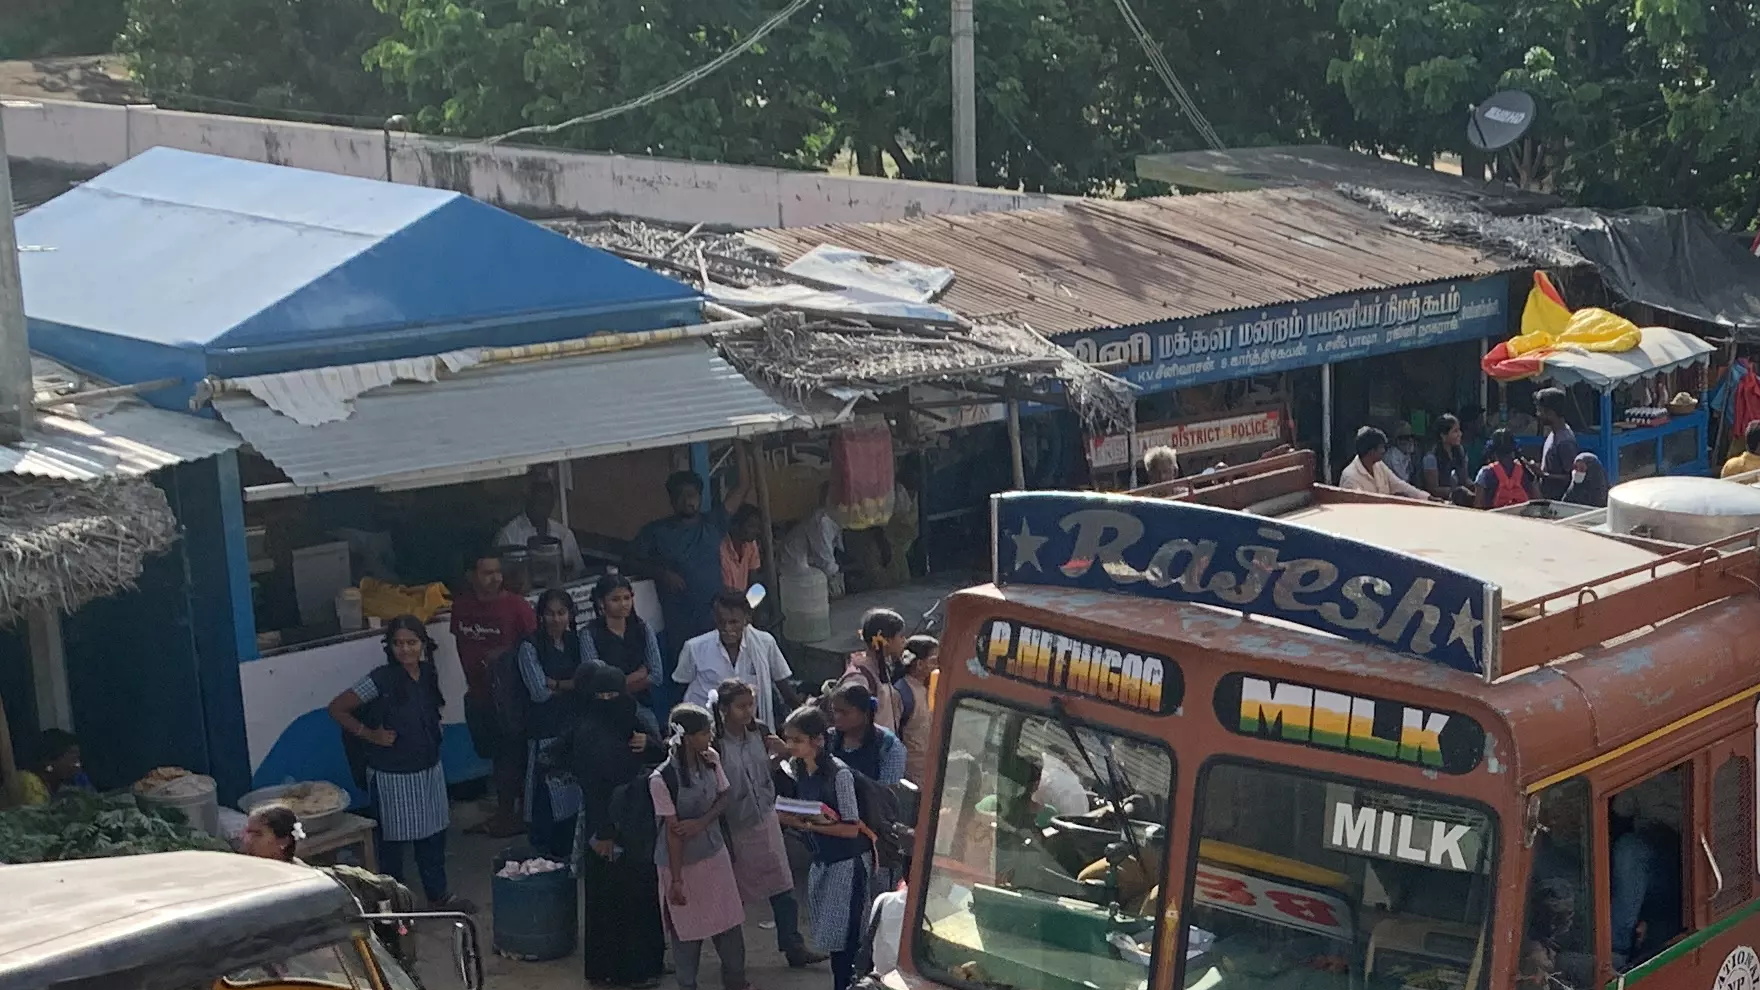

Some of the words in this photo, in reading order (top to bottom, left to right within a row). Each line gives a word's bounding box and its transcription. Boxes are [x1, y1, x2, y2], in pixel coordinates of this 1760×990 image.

[1170, 426, 1221, 449] DISTRICT
[1231, 418, 1269, 440] POLICE
[1058, 508, 1444, 655] Rajesh
[1239, 676, 1450, 768] MILK
[1331, 801, 1472, 872] MILK
